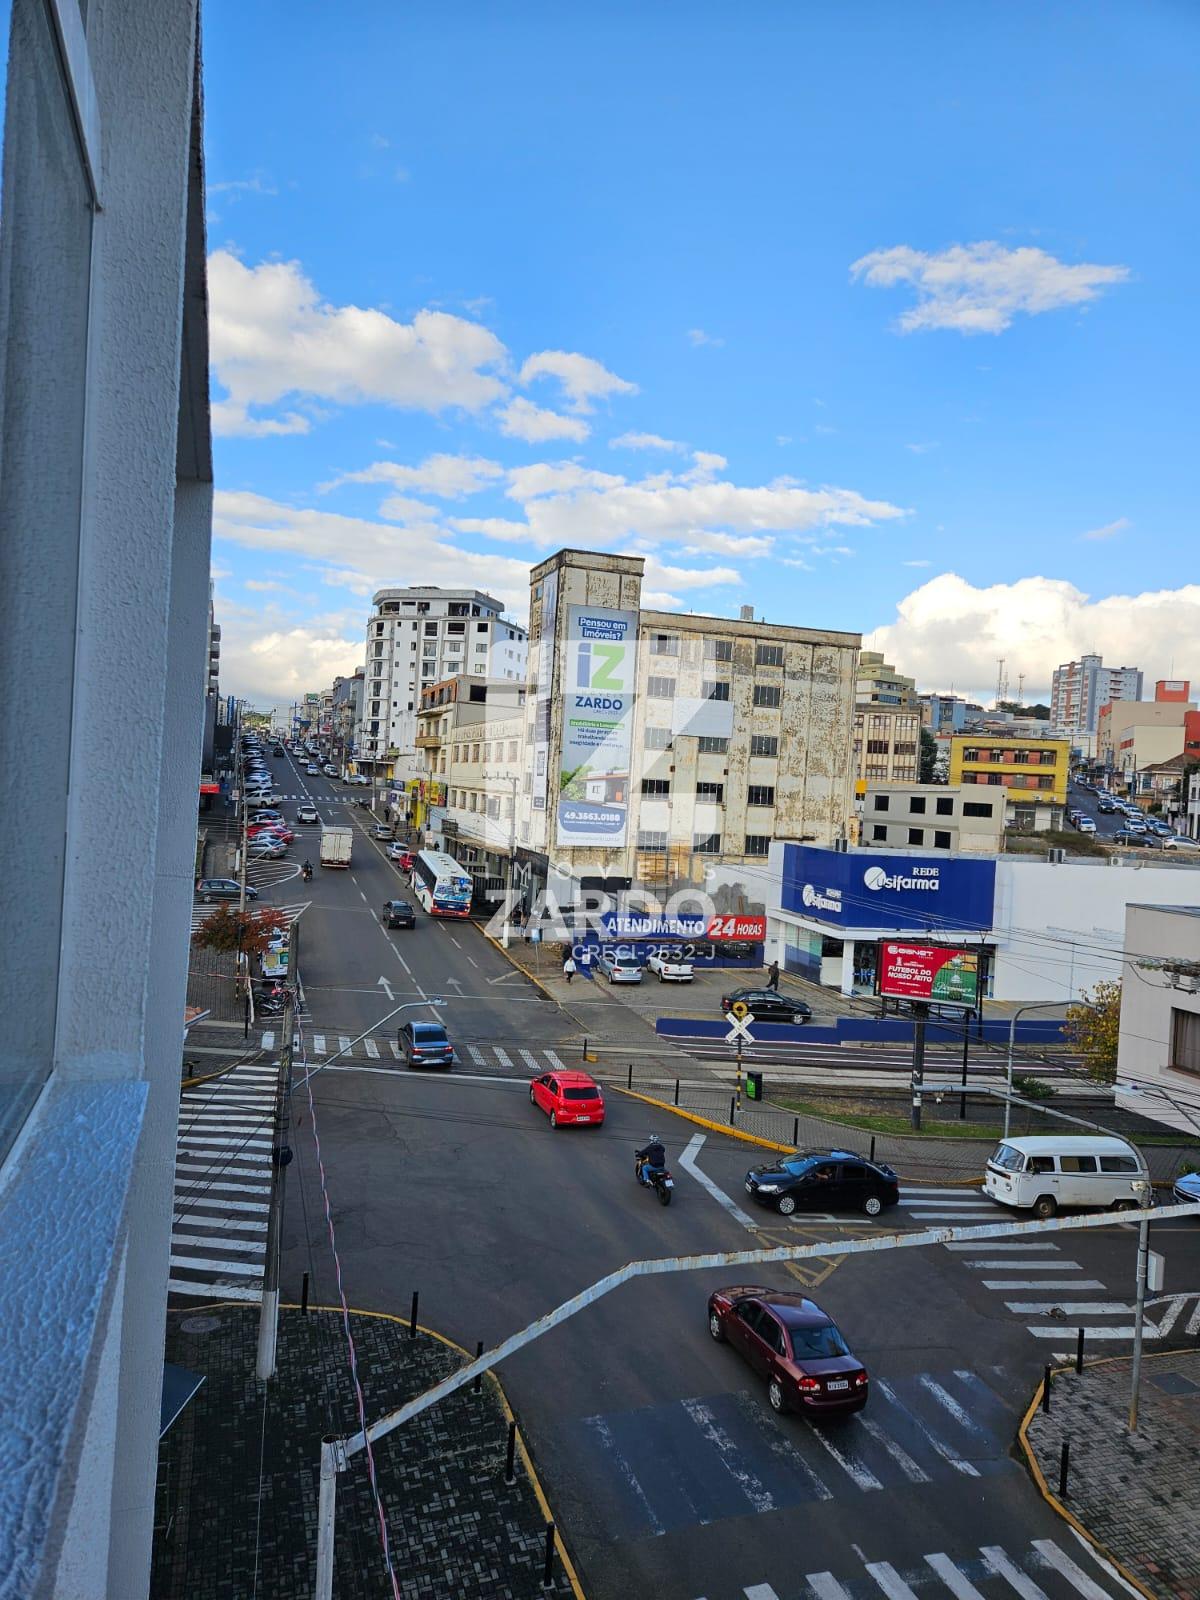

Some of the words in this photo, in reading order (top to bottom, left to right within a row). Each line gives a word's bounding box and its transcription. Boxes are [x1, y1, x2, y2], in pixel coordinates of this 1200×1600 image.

[580, 617, 612, 628] Pensou
[613, 621, 627, 630] em
[584, 630, 622, 640] imóveis?
[576, 696, 623, 711] ZARDO
[912, 867, 940, 877] REDE
[606, 917, 705, 935] ATENDIMENTO
[709, 918, 736, 936] 24
[737, 923, 763, 936] HORAS
[887, 965, 919, 975] FUTEBOL
[887, 971, 912, 980] NOSSO
[912, 975, 933, 983] JEITO
